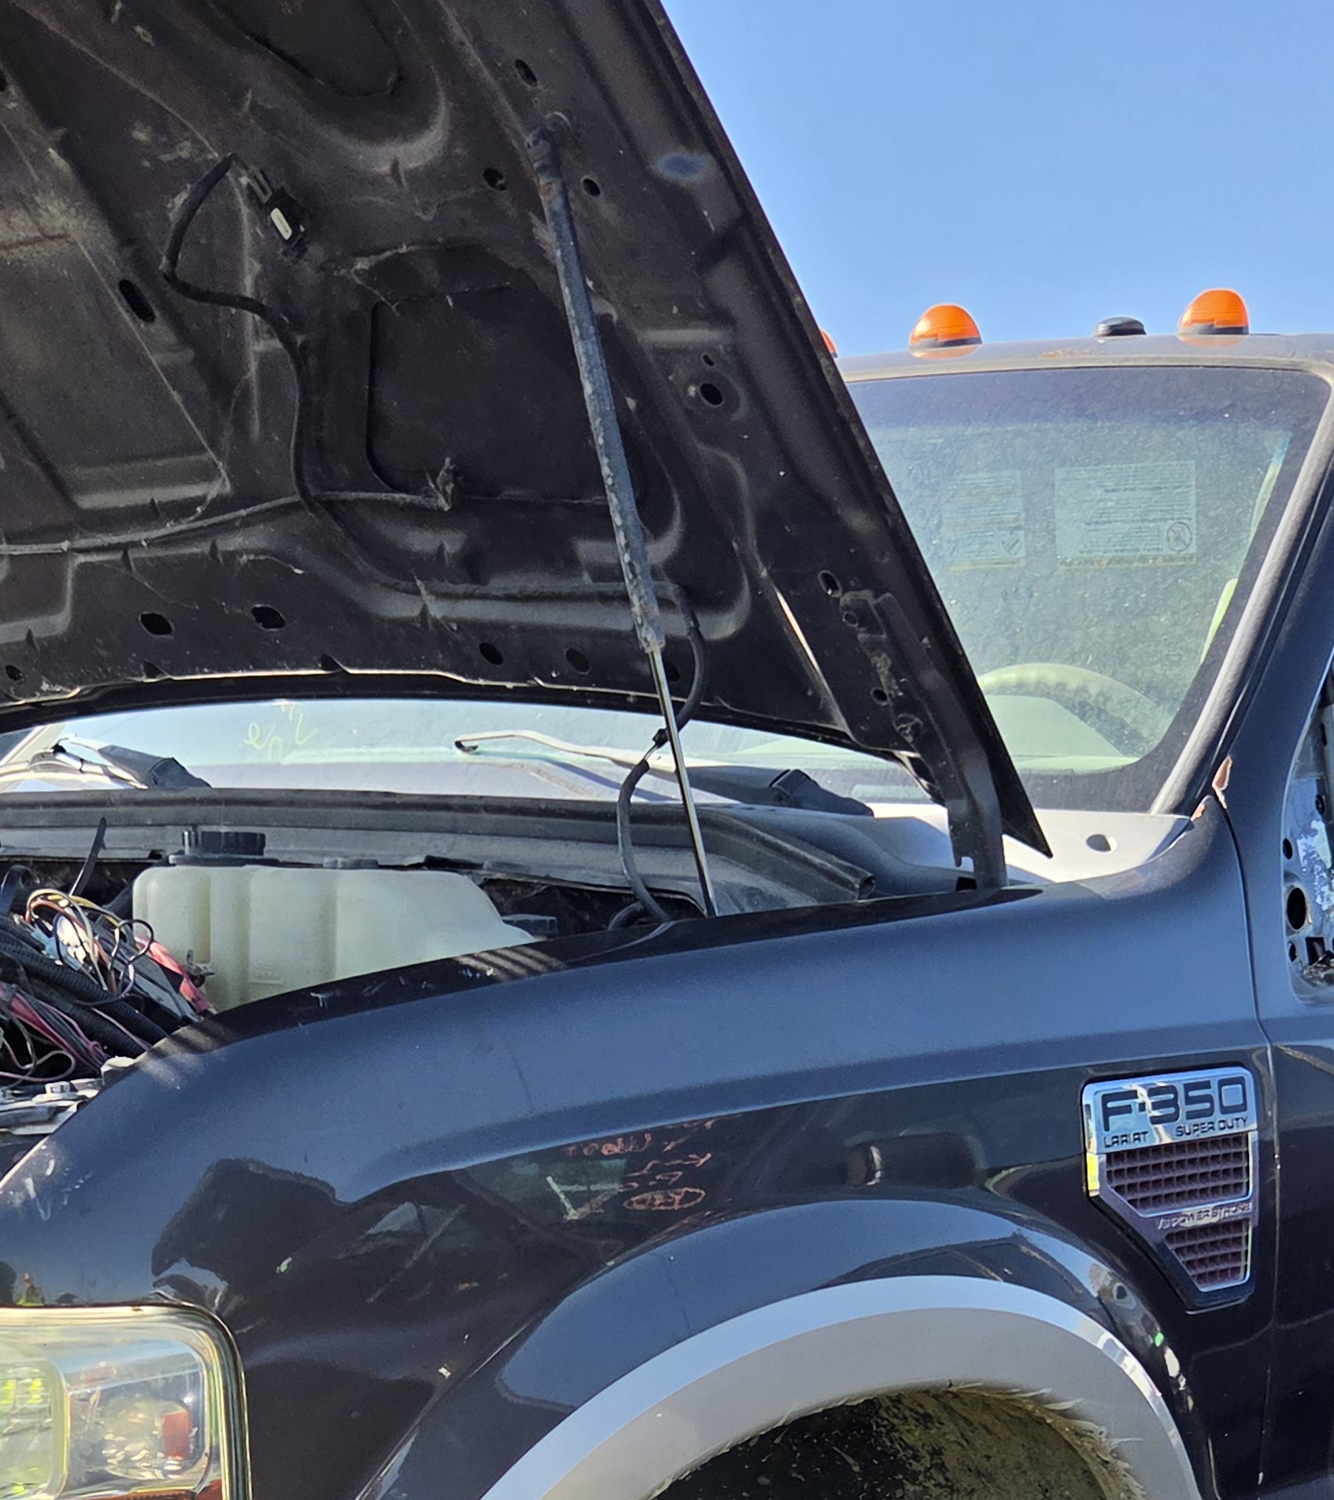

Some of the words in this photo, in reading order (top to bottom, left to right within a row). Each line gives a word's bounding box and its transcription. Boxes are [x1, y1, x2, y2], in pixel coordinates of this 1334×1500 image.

[1101, 1076, 1248, 1132] F-350
[1175, 1121, 1216, 1137] SUPER
[1218, 1116, 1248, 1131] DUTY
[1103, 1130, 1150, 1149] LARIAT
